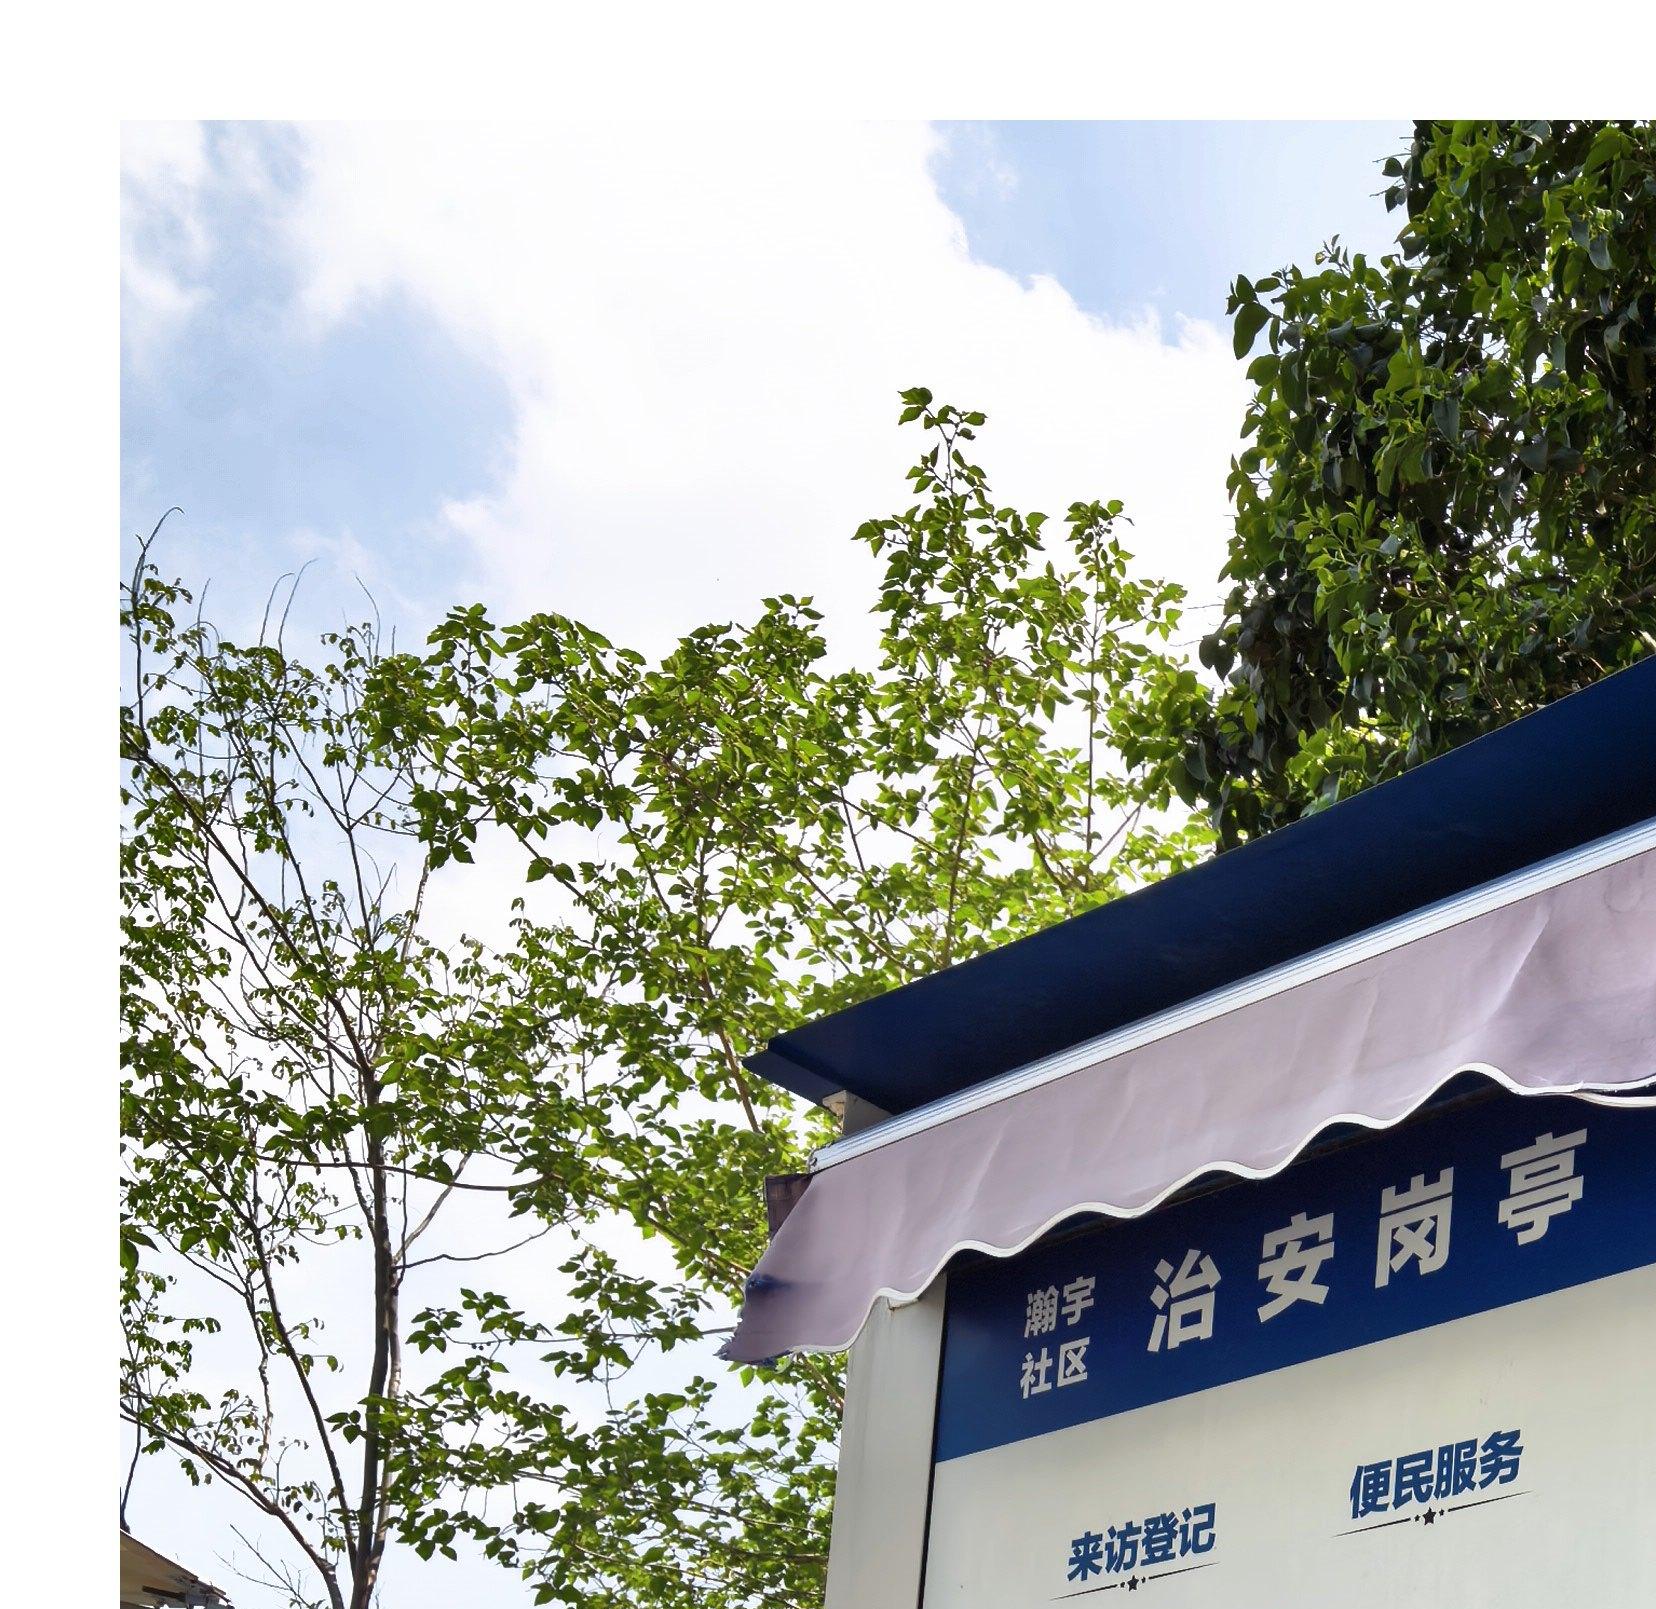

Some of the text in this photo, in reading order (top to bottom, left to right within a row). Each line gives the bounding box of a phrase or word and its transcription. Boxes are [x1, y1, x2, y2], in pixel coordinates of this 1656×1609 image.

[1146, 1128, 1588, 1353] 治安岗亭
[1023, 1275, 1096, 1338] 瀚宇
[1019, 1337, 1090, 1399] 社区
[1349, 1429, 1524, 1519] 便民服务
[1067, 1502, 1217, 1581] 来访登记
